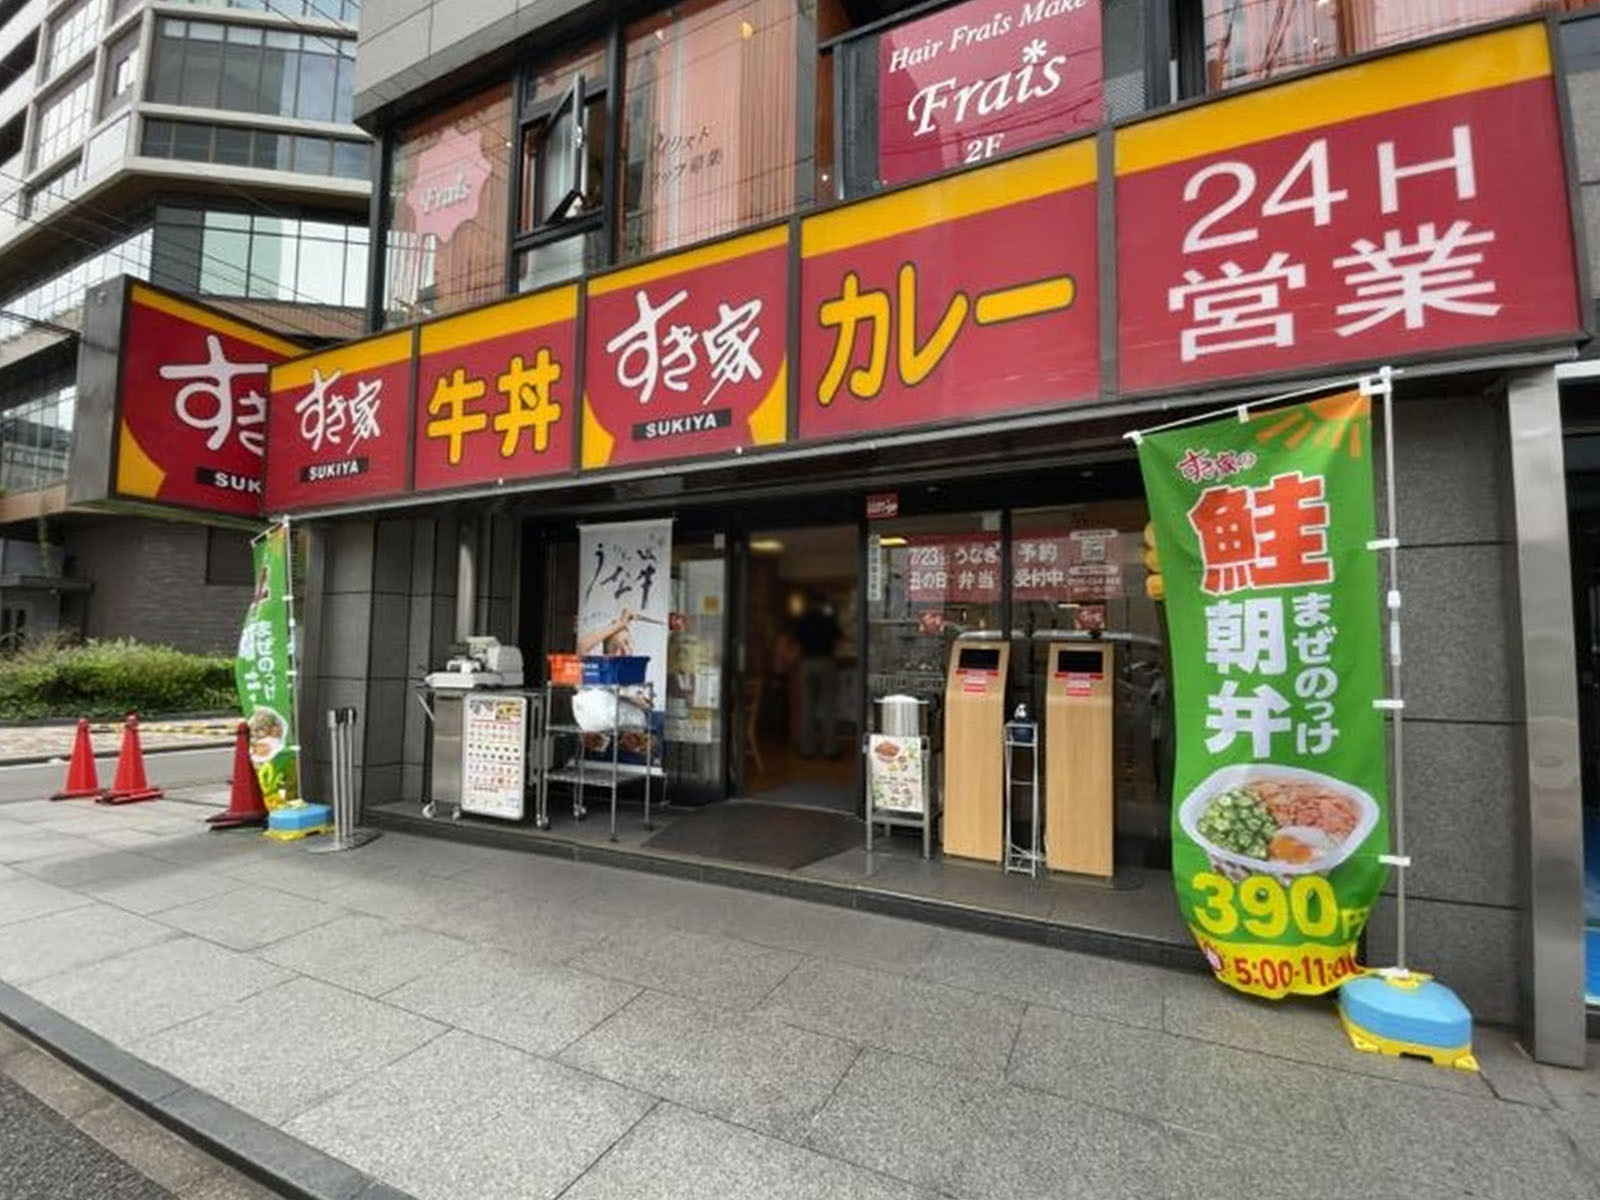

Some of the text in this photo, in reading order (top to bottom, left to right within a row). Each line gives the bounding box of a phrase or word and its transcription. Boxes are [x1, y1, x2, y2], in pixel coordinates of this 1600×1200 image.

[889, 0, 1088, 73] Hair Frais Make
[907, 40, 1067, 137] Frais
[964, 133, 1005, 164] 2F
[816, 260, 1076, 407] カレー
[1168, 219, 1502, 363] 営業
[606, 289, 763, 405] すき家
[295, 368, 382, 454] すき家
[426, 348, 562, 465] 牛丼
[645, 412, 717, 439] SUKIYA
[308, 460, 359, 481] SUKIYA
[958, 569, 994, 590] 弁当
[1014, 567, 1064, 588] 受付中
[1018, 541, 1058, 563] 予約
[1187, 471, 1334, 596] 鮭
[1204, 596, 1292, 759] 朝弁
[1292, 592, 1340, 756] まぜのっけ
